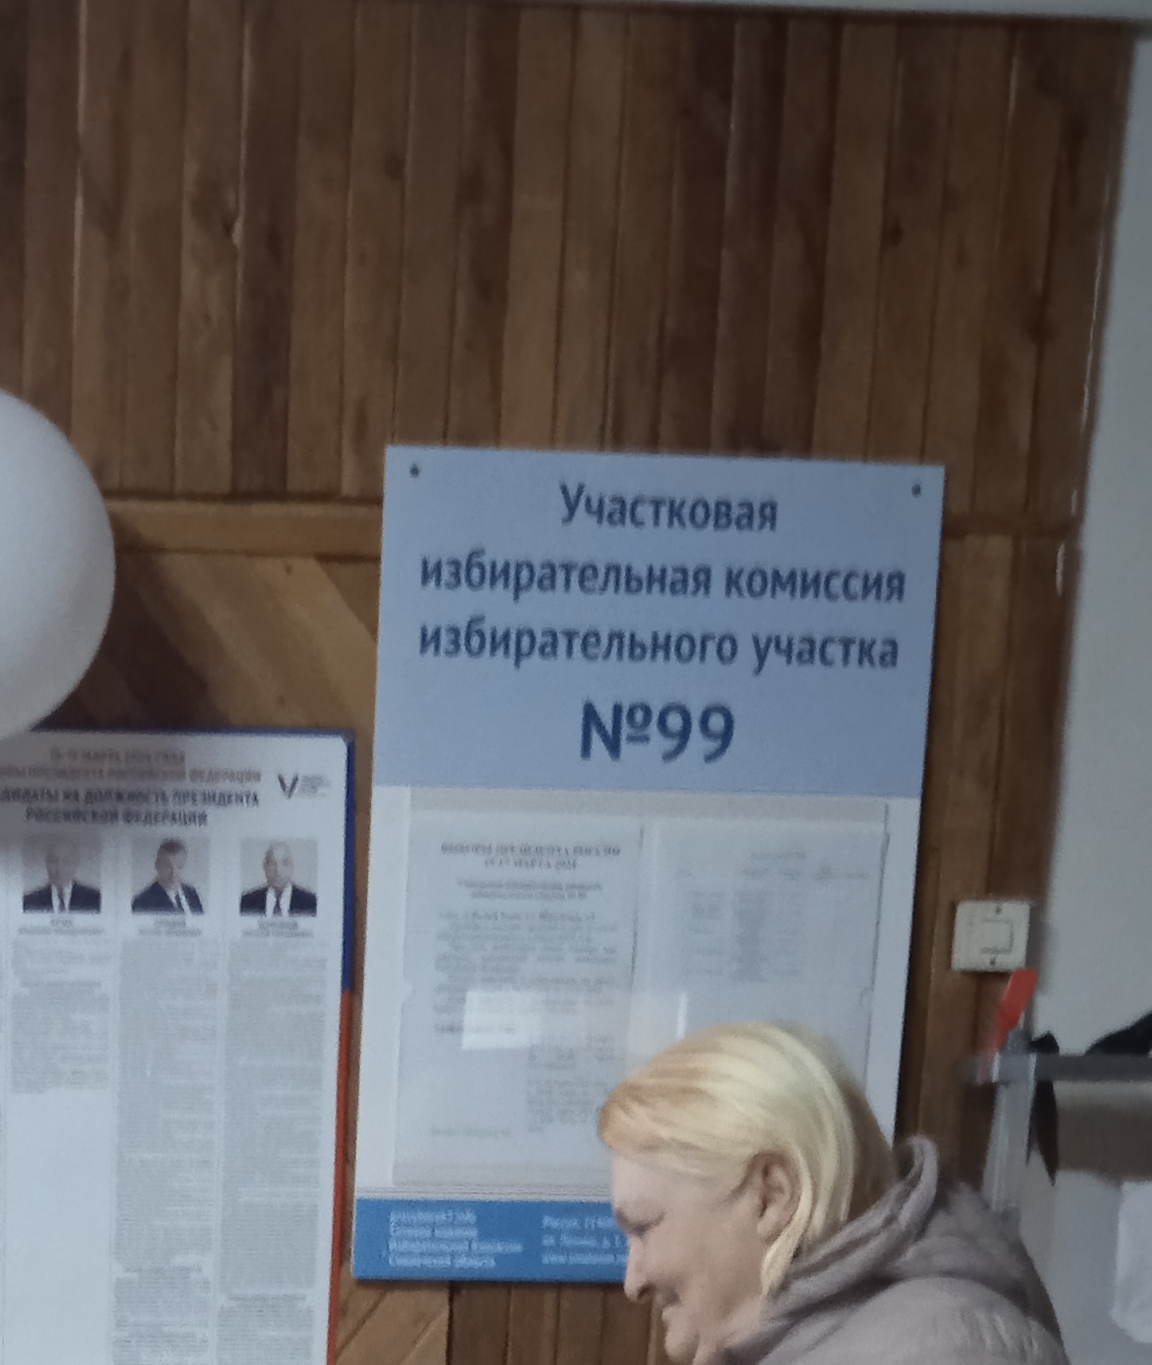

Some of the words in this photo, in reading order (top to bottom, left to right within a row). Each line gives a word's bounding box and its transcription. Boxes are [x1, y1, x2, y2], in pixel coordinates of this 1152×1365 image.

[559, 481, 778, 533] Участковая
[419, 547, 711, 604] избирательная
[724, 564, 906, 603] комиссия
[418, 614, 739, 670] избирательного
[752, 629, 900, 676] участка
[579, 700, 736, 765] №99
